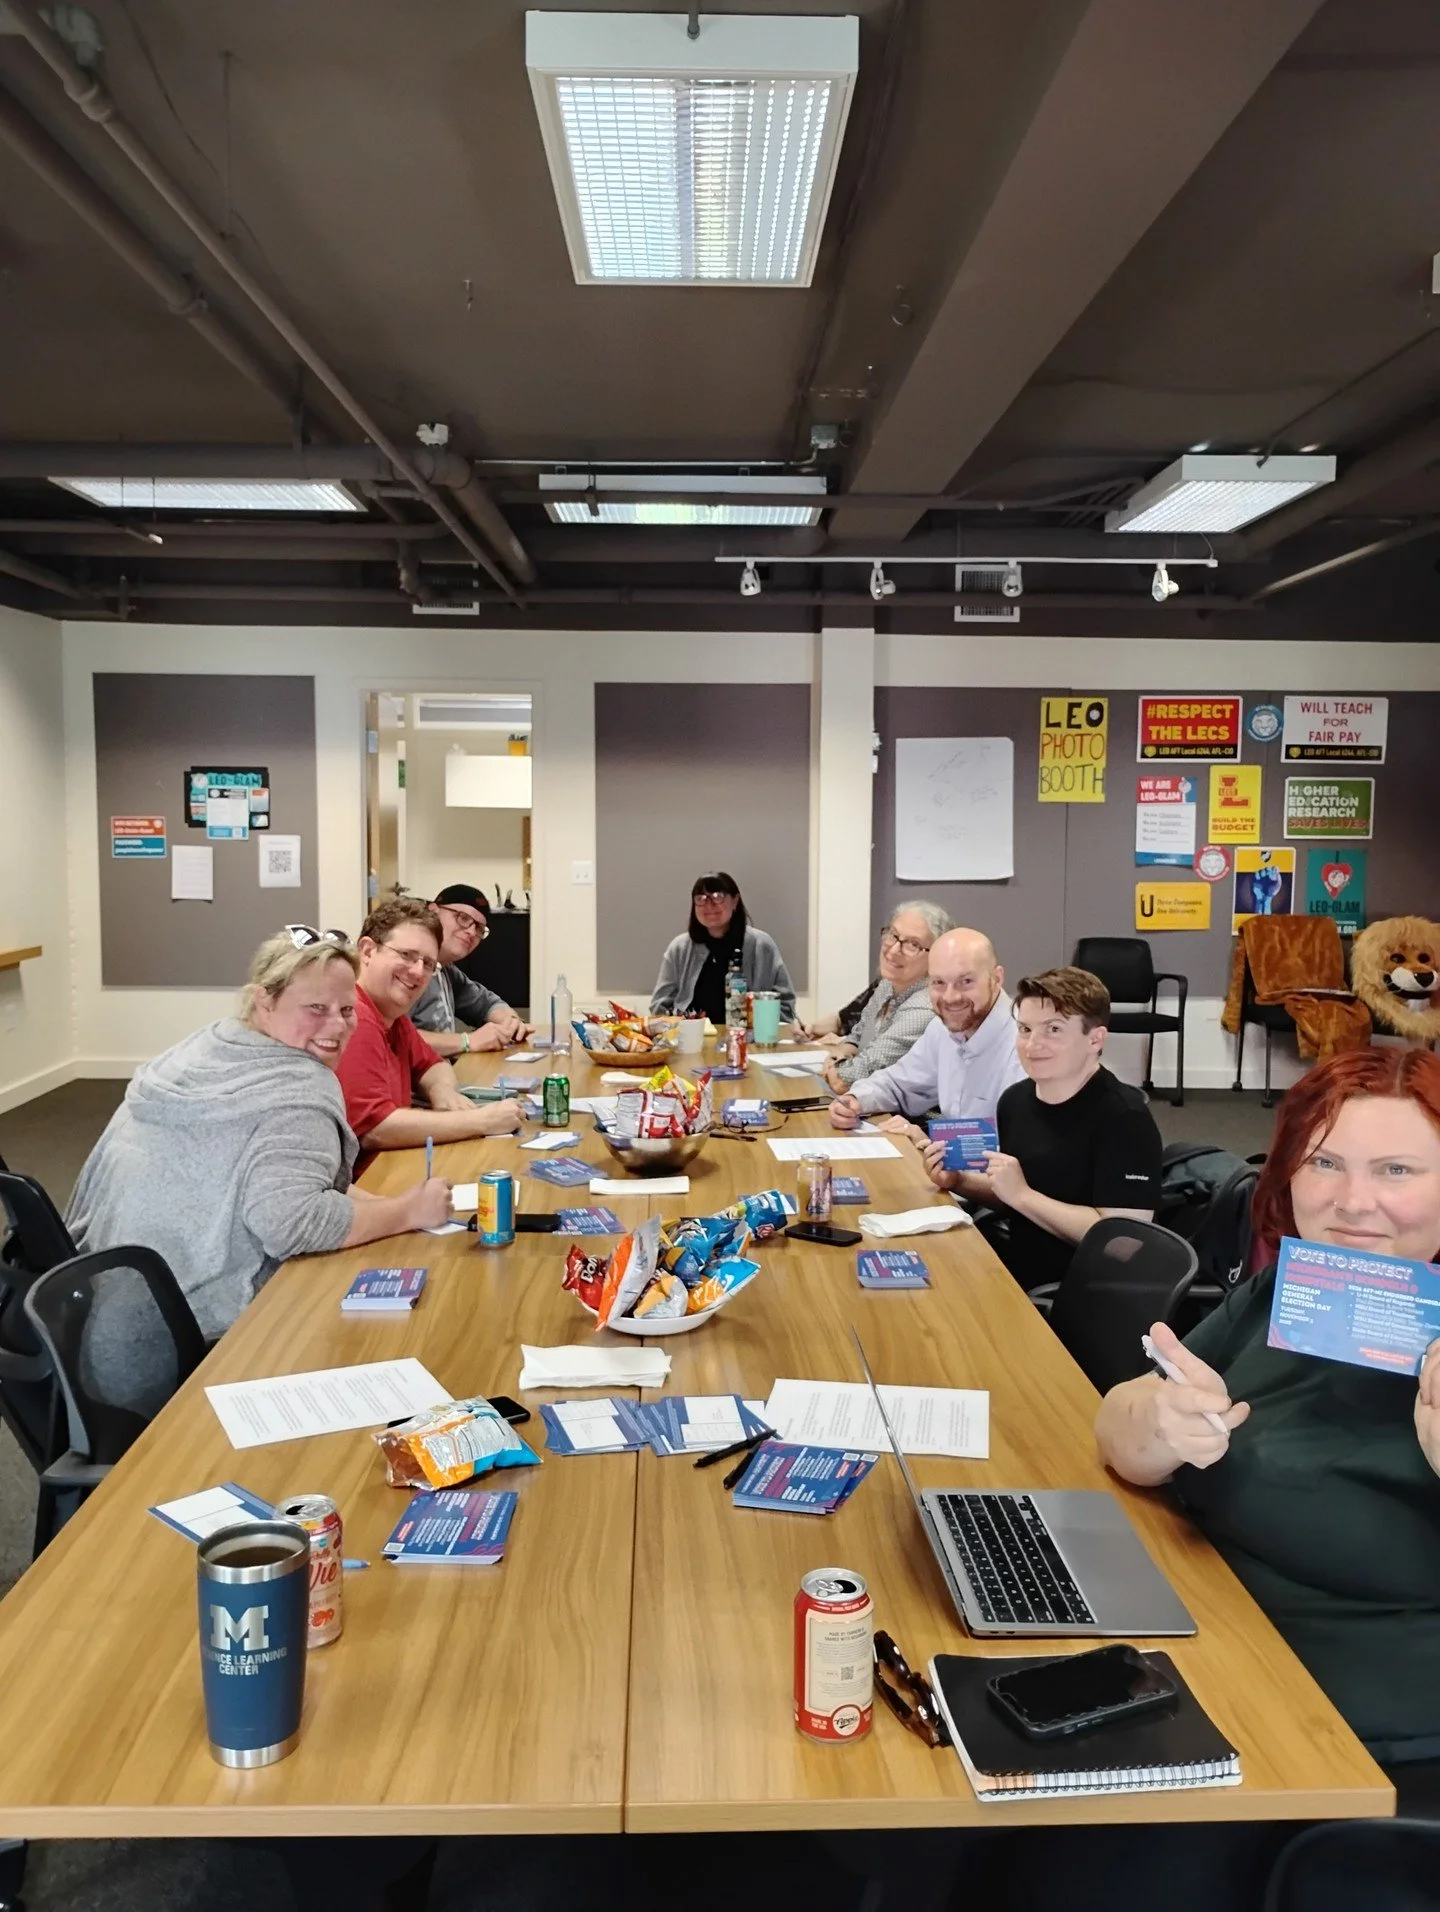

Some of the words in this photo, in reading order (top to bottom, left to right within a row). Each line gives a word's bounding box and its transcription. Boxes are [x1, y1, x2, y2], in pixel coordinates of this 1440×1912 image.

[1147, 704, 1234, 719] #RESPECT
[1300, 702, 1328, 714] WILL
[1334, 702, 1372, 714] TEACH
[1046, 702, 1104, 729] LEO
[1323, 718, 1348, 727] FOR
[1148, 726, 1182, 740] THE
[1186, 726, 1230, 740] LECS
[1308, 731, 1334, 742] FAIR
[1339, 732, 1362, 742] PAY
[1040, 732, 1105, 760] PHOTO
[1040, 764, 1106, 794] BOOTH
[1140, 780, 1154, 790] WE
[1156, 780, 1171, 790] ARE
[1288, 807, 1356, 817] RESEARCH
[1309, 900, 1360, 913] LEO-GLAM
[1288, 1245, 1326, 1264] VOTE
[1327, 1252, 1348, 1268] TO
[1348, 1258, 1414, 1280] PROTECT
[1282, 1283, 1321, 1295] MICHIGAN
[1281, 1296, 1316, 1308] ELECTION
[1282, 1290, 1314, 1302] GENERAL
[210, 1604, 269, 1651] M
[234, 1647, 288, 1665] LEARNING
[219, 1664, 259, 1676] CENTER
